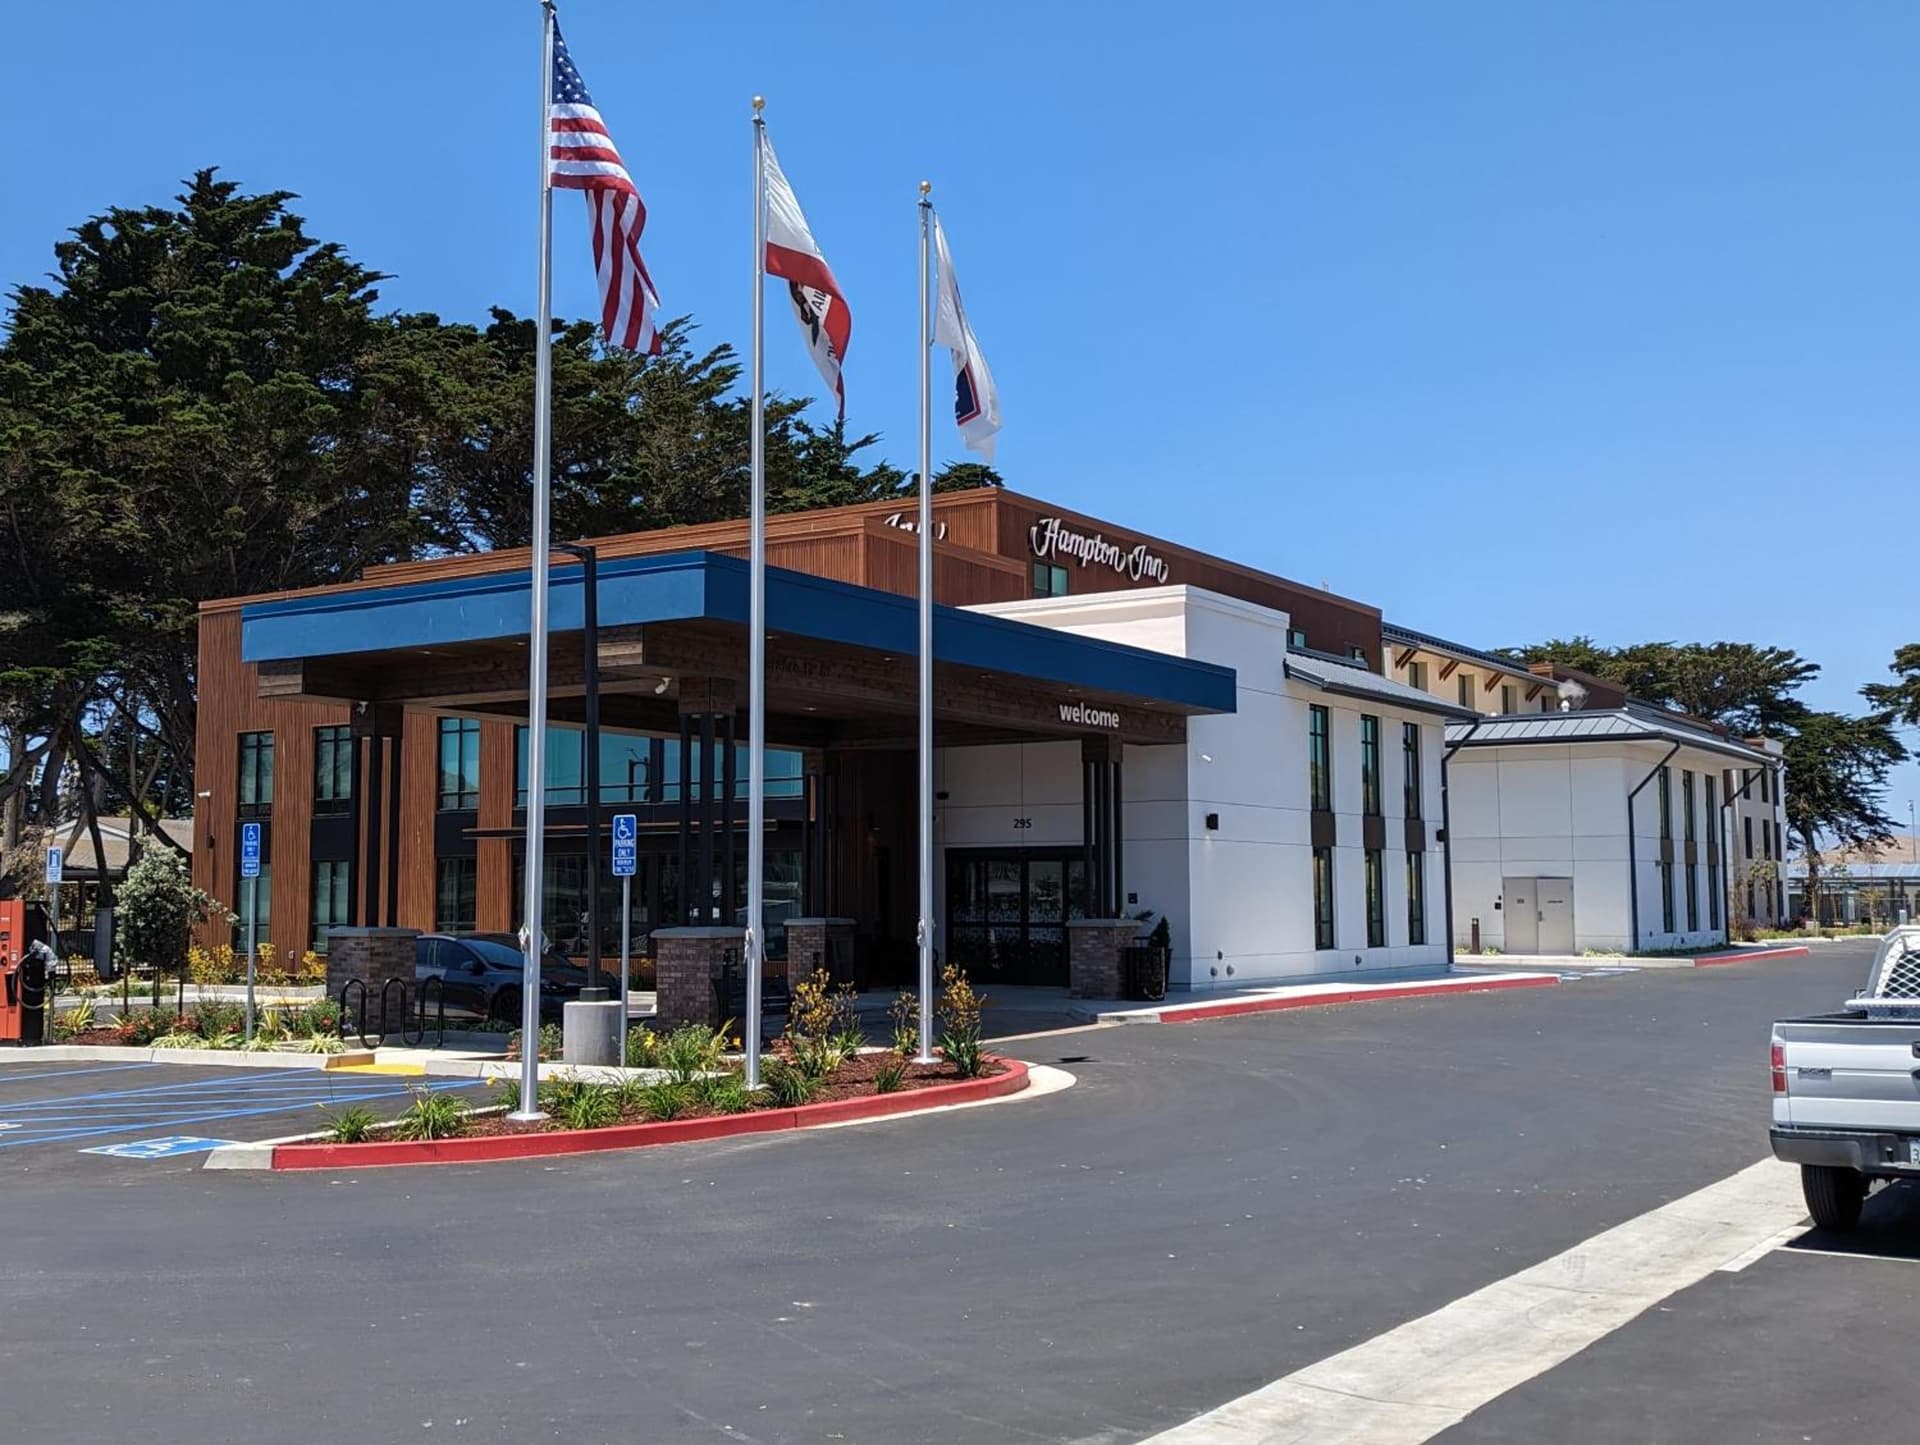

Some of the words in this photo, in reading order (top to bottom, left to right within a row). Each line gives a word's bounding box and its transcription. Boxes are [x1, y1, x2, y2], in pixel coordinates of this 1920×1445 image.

[1030, 518, 1126, 572] Hampton
[1127, 544, 1169, 583] Inn
[1059, 701, 1120, 728] welcome
[1013, 818, 1032, 829] 295
[618, 848, 631, 857] ONLY
